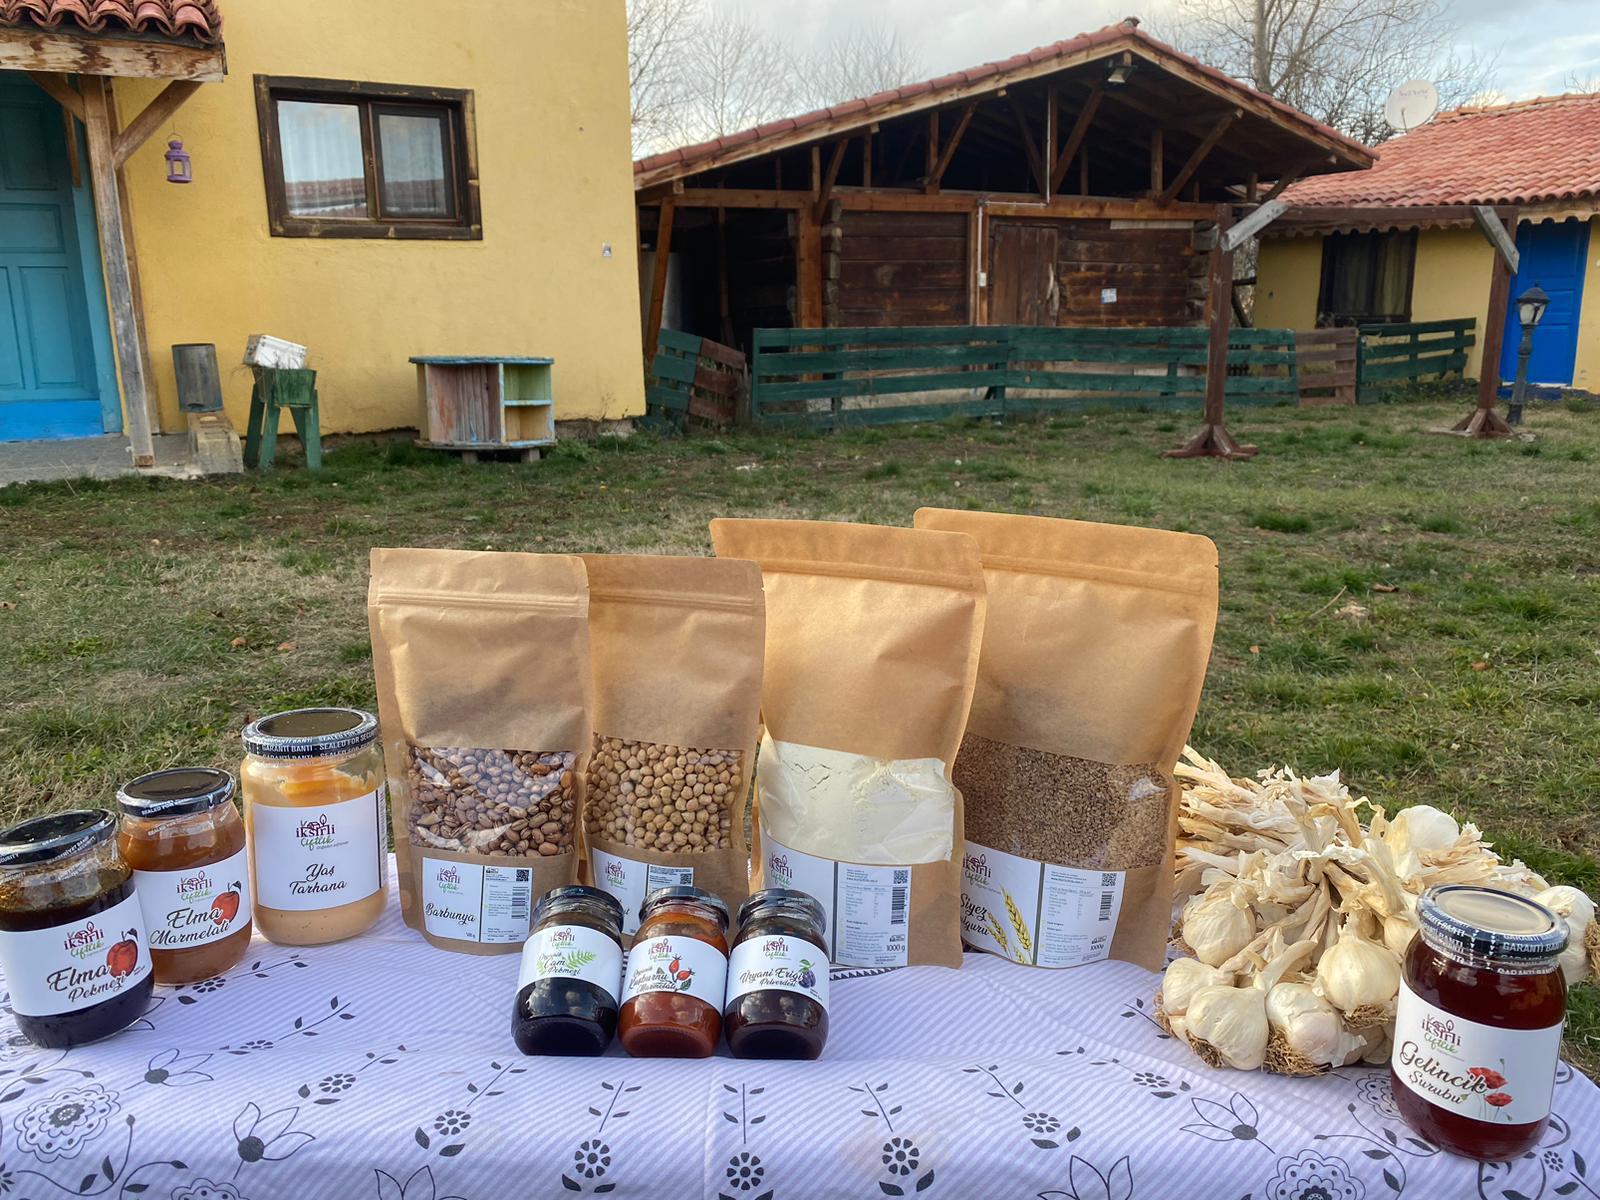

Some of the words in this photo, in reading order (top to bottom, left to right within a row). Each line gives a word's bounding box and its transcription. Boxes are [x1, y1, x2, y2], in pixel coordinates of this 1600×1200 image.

[295, 824, 335, 838] iksirli
[306, 864, 336, 882] Yaş
[177, 879, 212, 893] iksirli
[289, 880, 347, 895] Tarhana
[166, 907, 223, 929] Elma
[425, 902, 476, 925] Barbunya
[960, 892, 987, 922] Siyez
[64, 929, 105, 950] iksirli
[886, 943, 900, 952] 1000
[46, 965, 112, 991] Elma
[68, 971, 126, 1003] Pekmezi
[1422, 1018, 1461, 1047] iksirli
[1399, 1041, 1488, 1094] Gelincik
